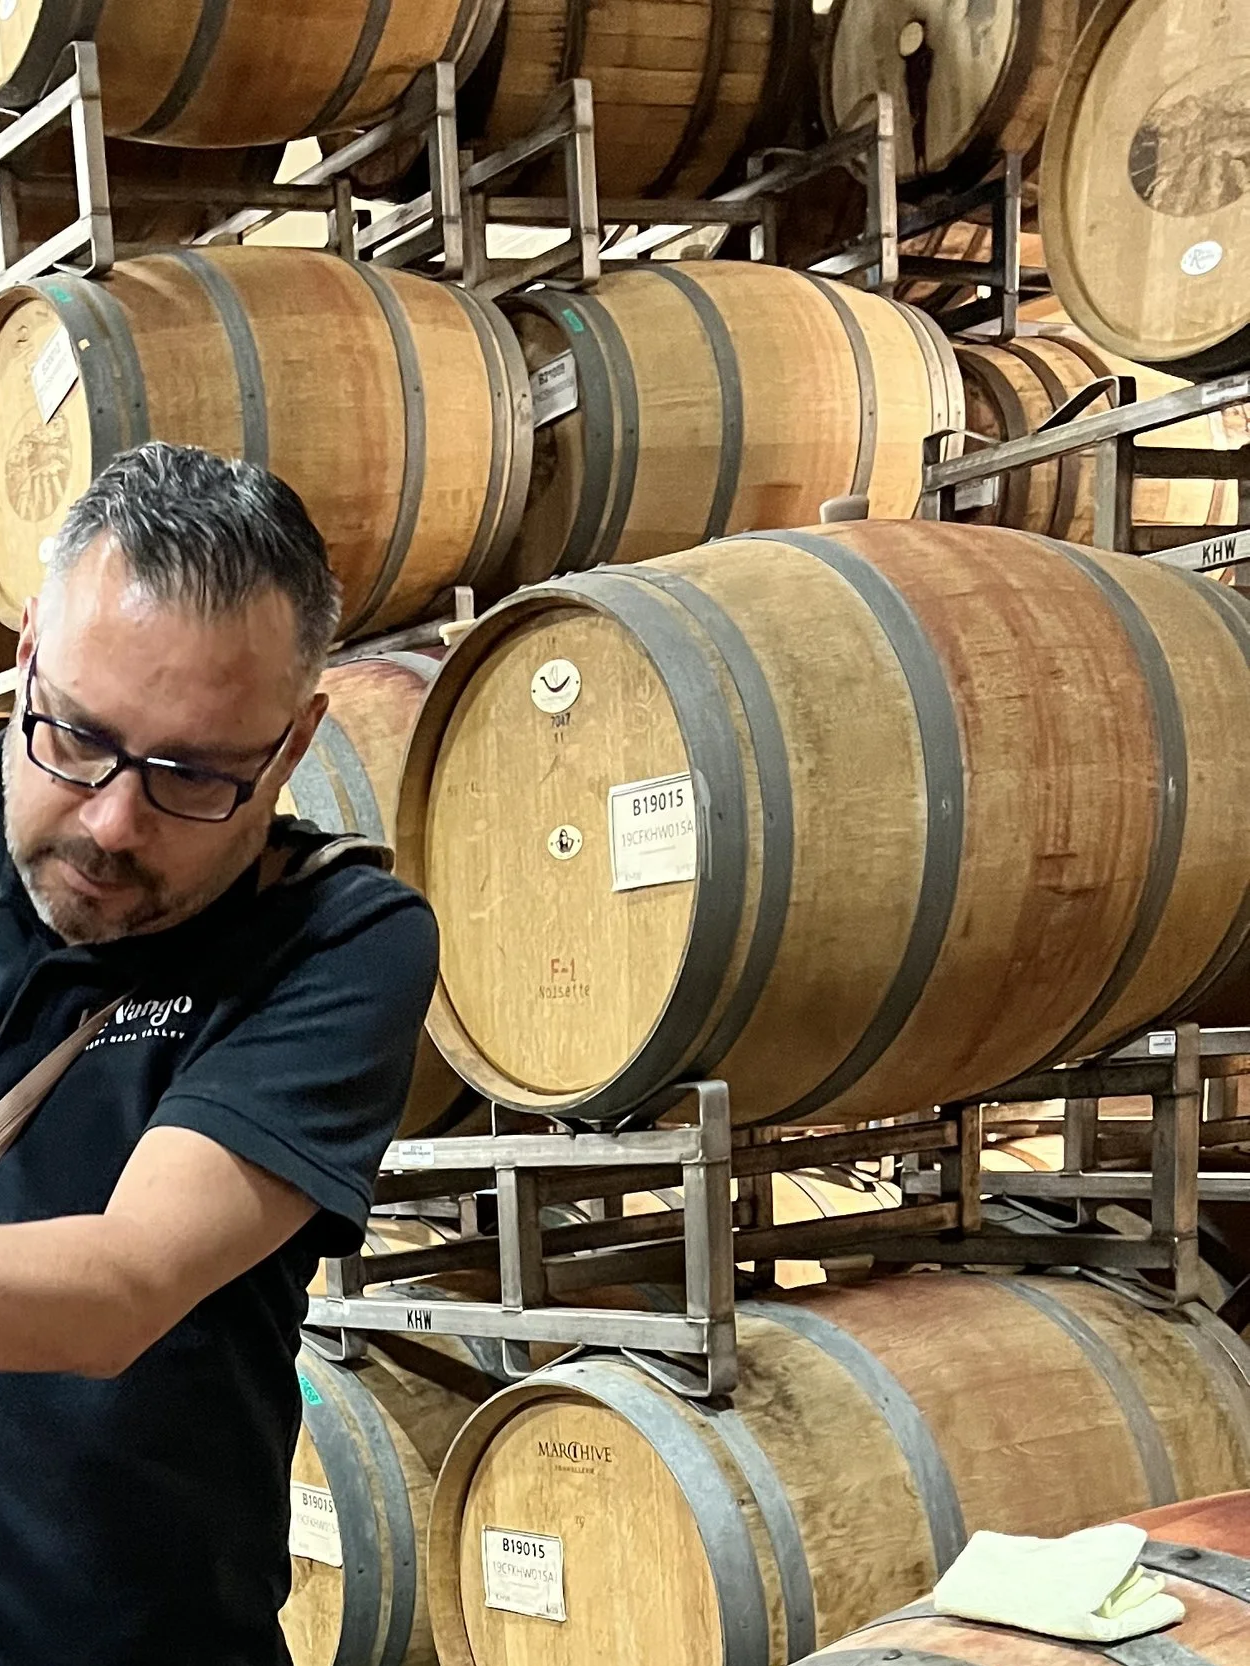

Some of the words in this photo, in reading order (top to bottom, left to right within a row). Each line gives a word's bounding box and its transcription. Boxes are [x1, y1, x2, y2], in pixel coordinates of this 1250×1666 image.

[1202, 537, 1236, 565] KHW
[633, 788, 684, 816] B19015
[79, 995, 192, 1035] Vango
[110, 1033, 137, 1043] NAPA
[142, 1028, 185, 1040] VALLEY
[407, 1309, 432, 1330] KHW
[302, 1492, 334, 1513] B19015
[502, 1537, 546, 1559] B19015
